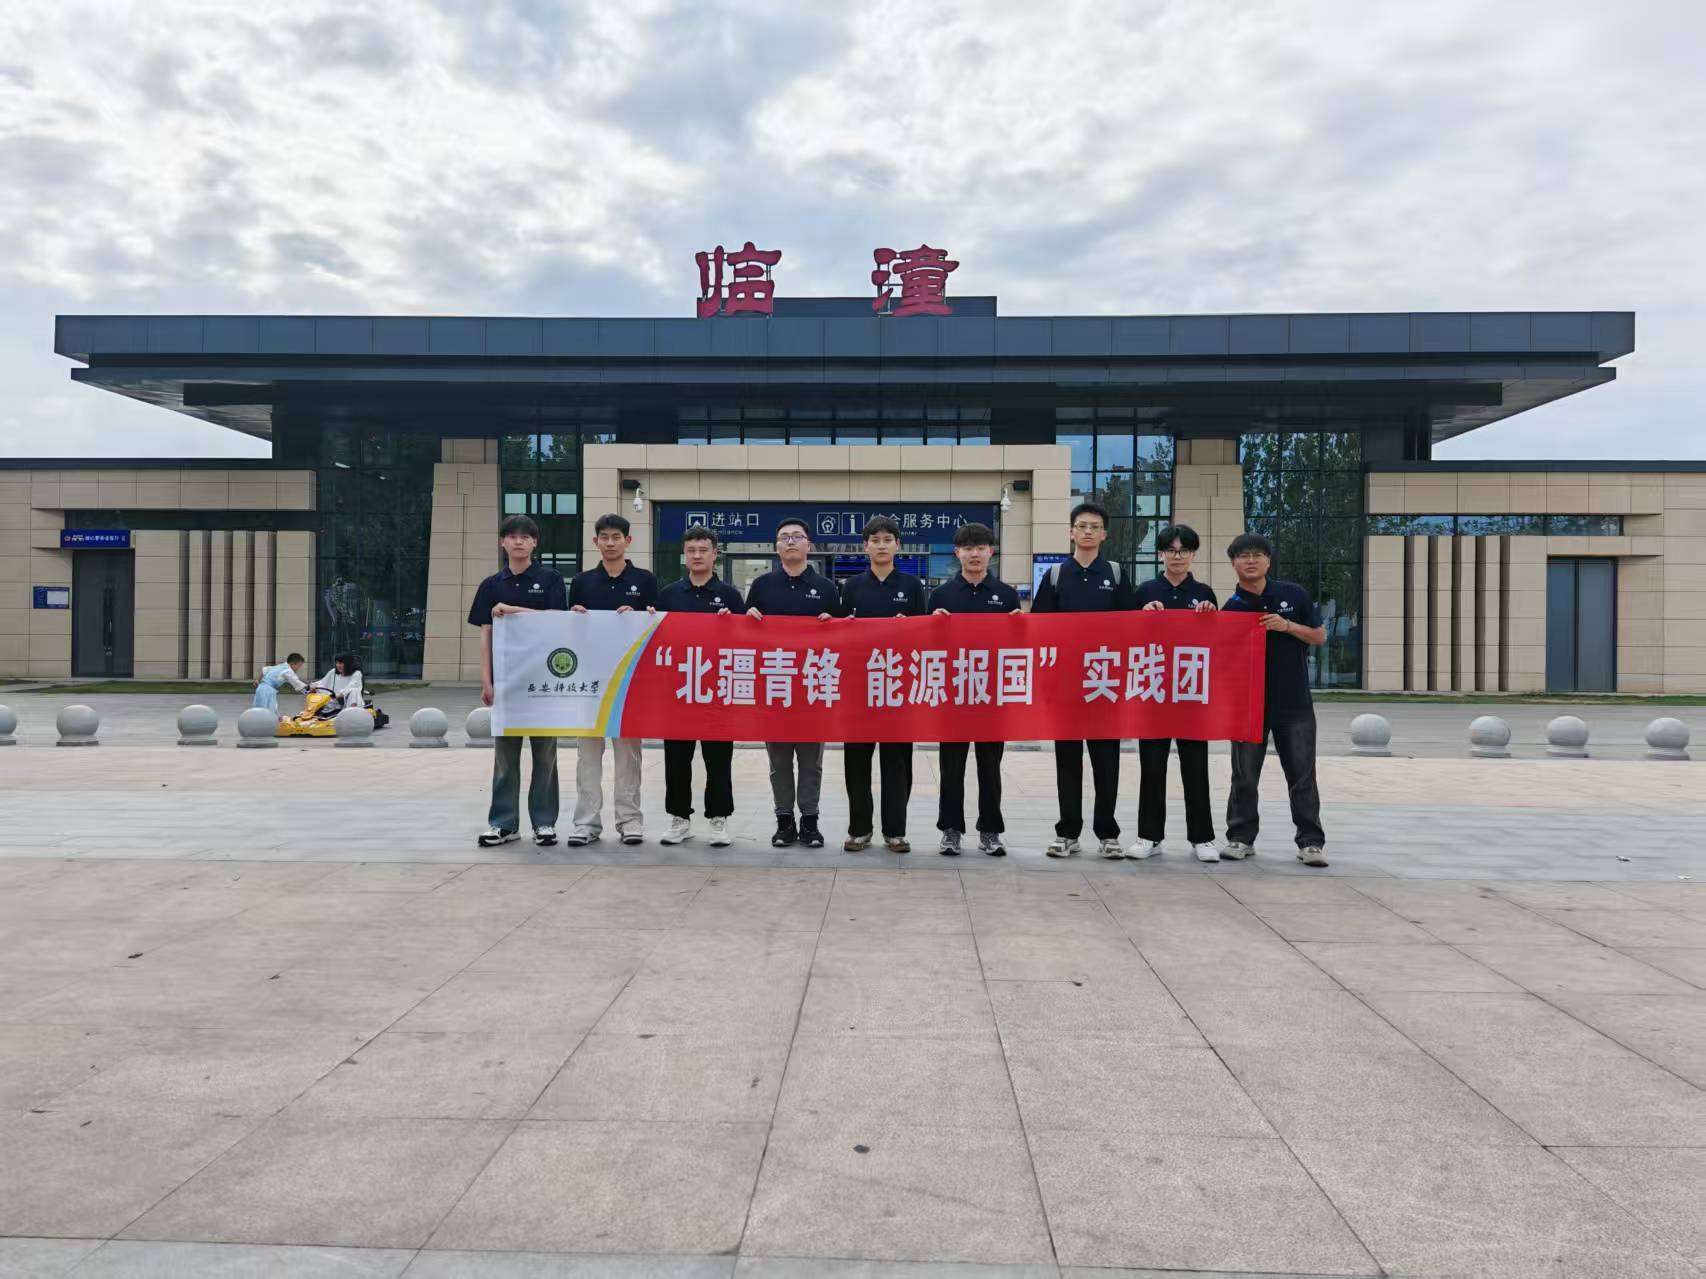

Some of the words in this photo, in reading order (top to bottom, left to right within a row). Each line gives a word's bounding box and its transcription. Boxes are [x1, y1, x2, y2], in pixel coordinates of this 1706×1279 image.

[695, 241, 960, 318] 临潼
[711, 511, 760, 527] 进站口
[654, 645, 843, 708] “北疆青锋
[866, 646, 1057, 708] 能源报国”
[1081, 643, 1210, 705] 实践团
